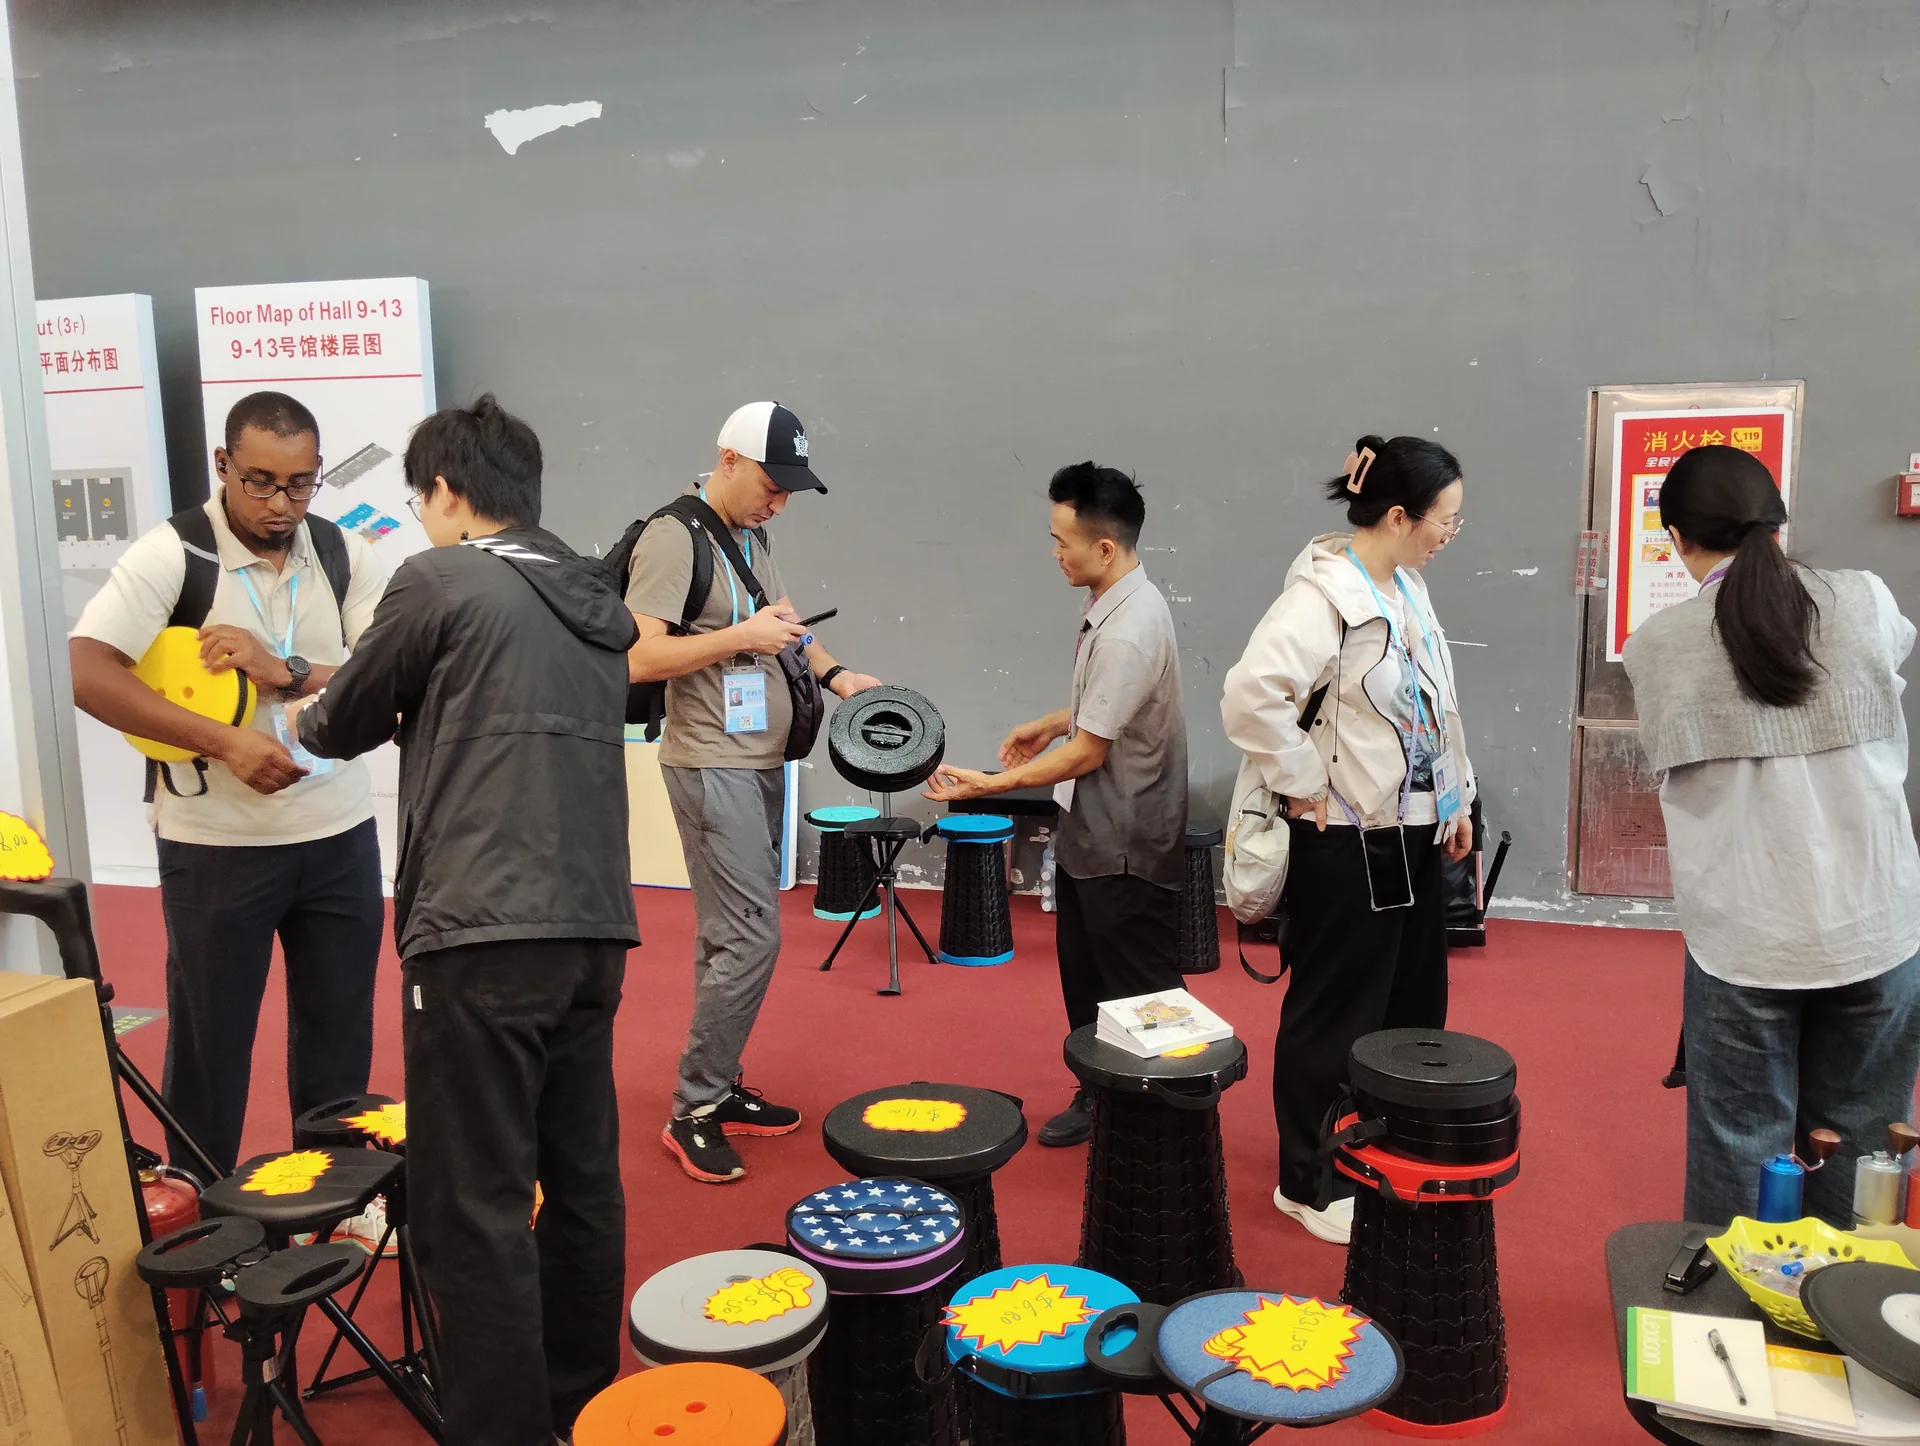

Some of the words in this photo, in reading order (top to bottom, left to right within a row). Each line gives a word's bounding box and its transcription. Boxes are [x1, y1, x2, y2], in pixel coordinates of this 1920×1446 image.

[210, 306, 252, 325] Floor
[257, 304, 293, 326] Map
[298, 301, 315, 321] of
[319, 300, 352, 320] Hall
[357, 298, 402, 319] 9-13
[231, 332, 382, 359] 9-13号馆楼层图
[1643, 429, 1726, 452] 消火栓
[1743, 431, 1760, 441] 119
[1642, 1312, 1669, 1366] Lexicon
